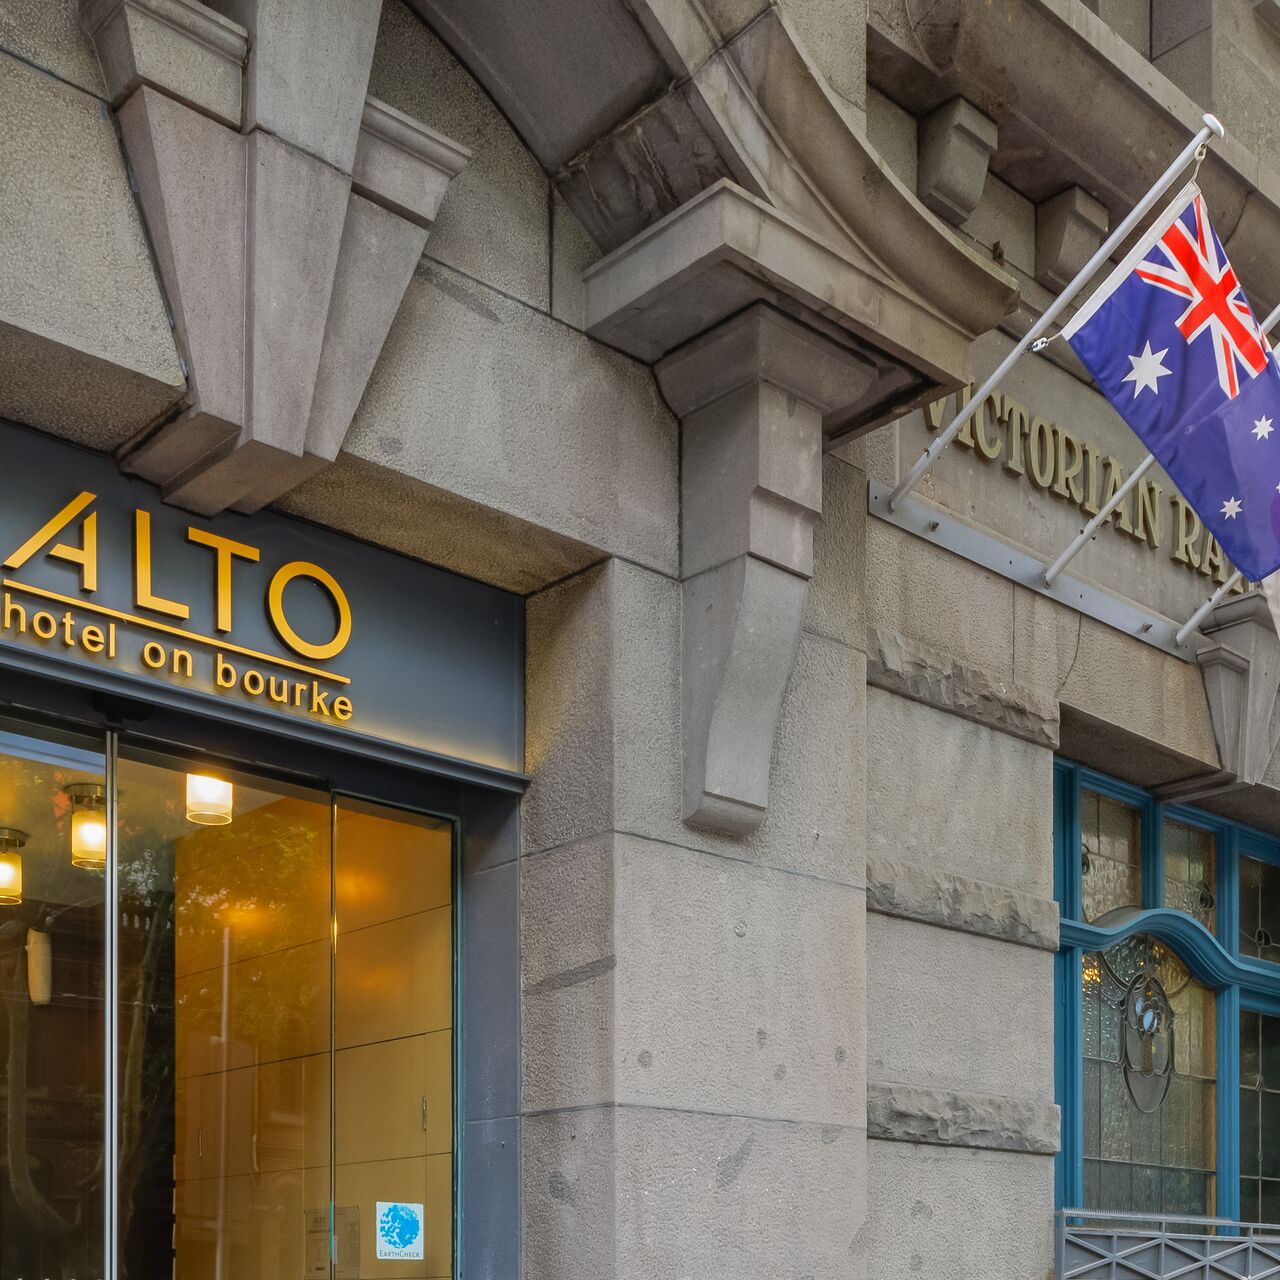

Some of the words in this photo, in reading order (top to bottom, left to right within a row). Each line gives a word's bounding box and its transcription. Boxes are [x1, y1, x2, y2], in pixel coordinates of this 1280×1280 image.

[0, 491, 352, 660] ALTO
[2, 593, 116, 658] hotel
[142, 641, 194, 678] on
[216, 653, 354, 721] bourke
